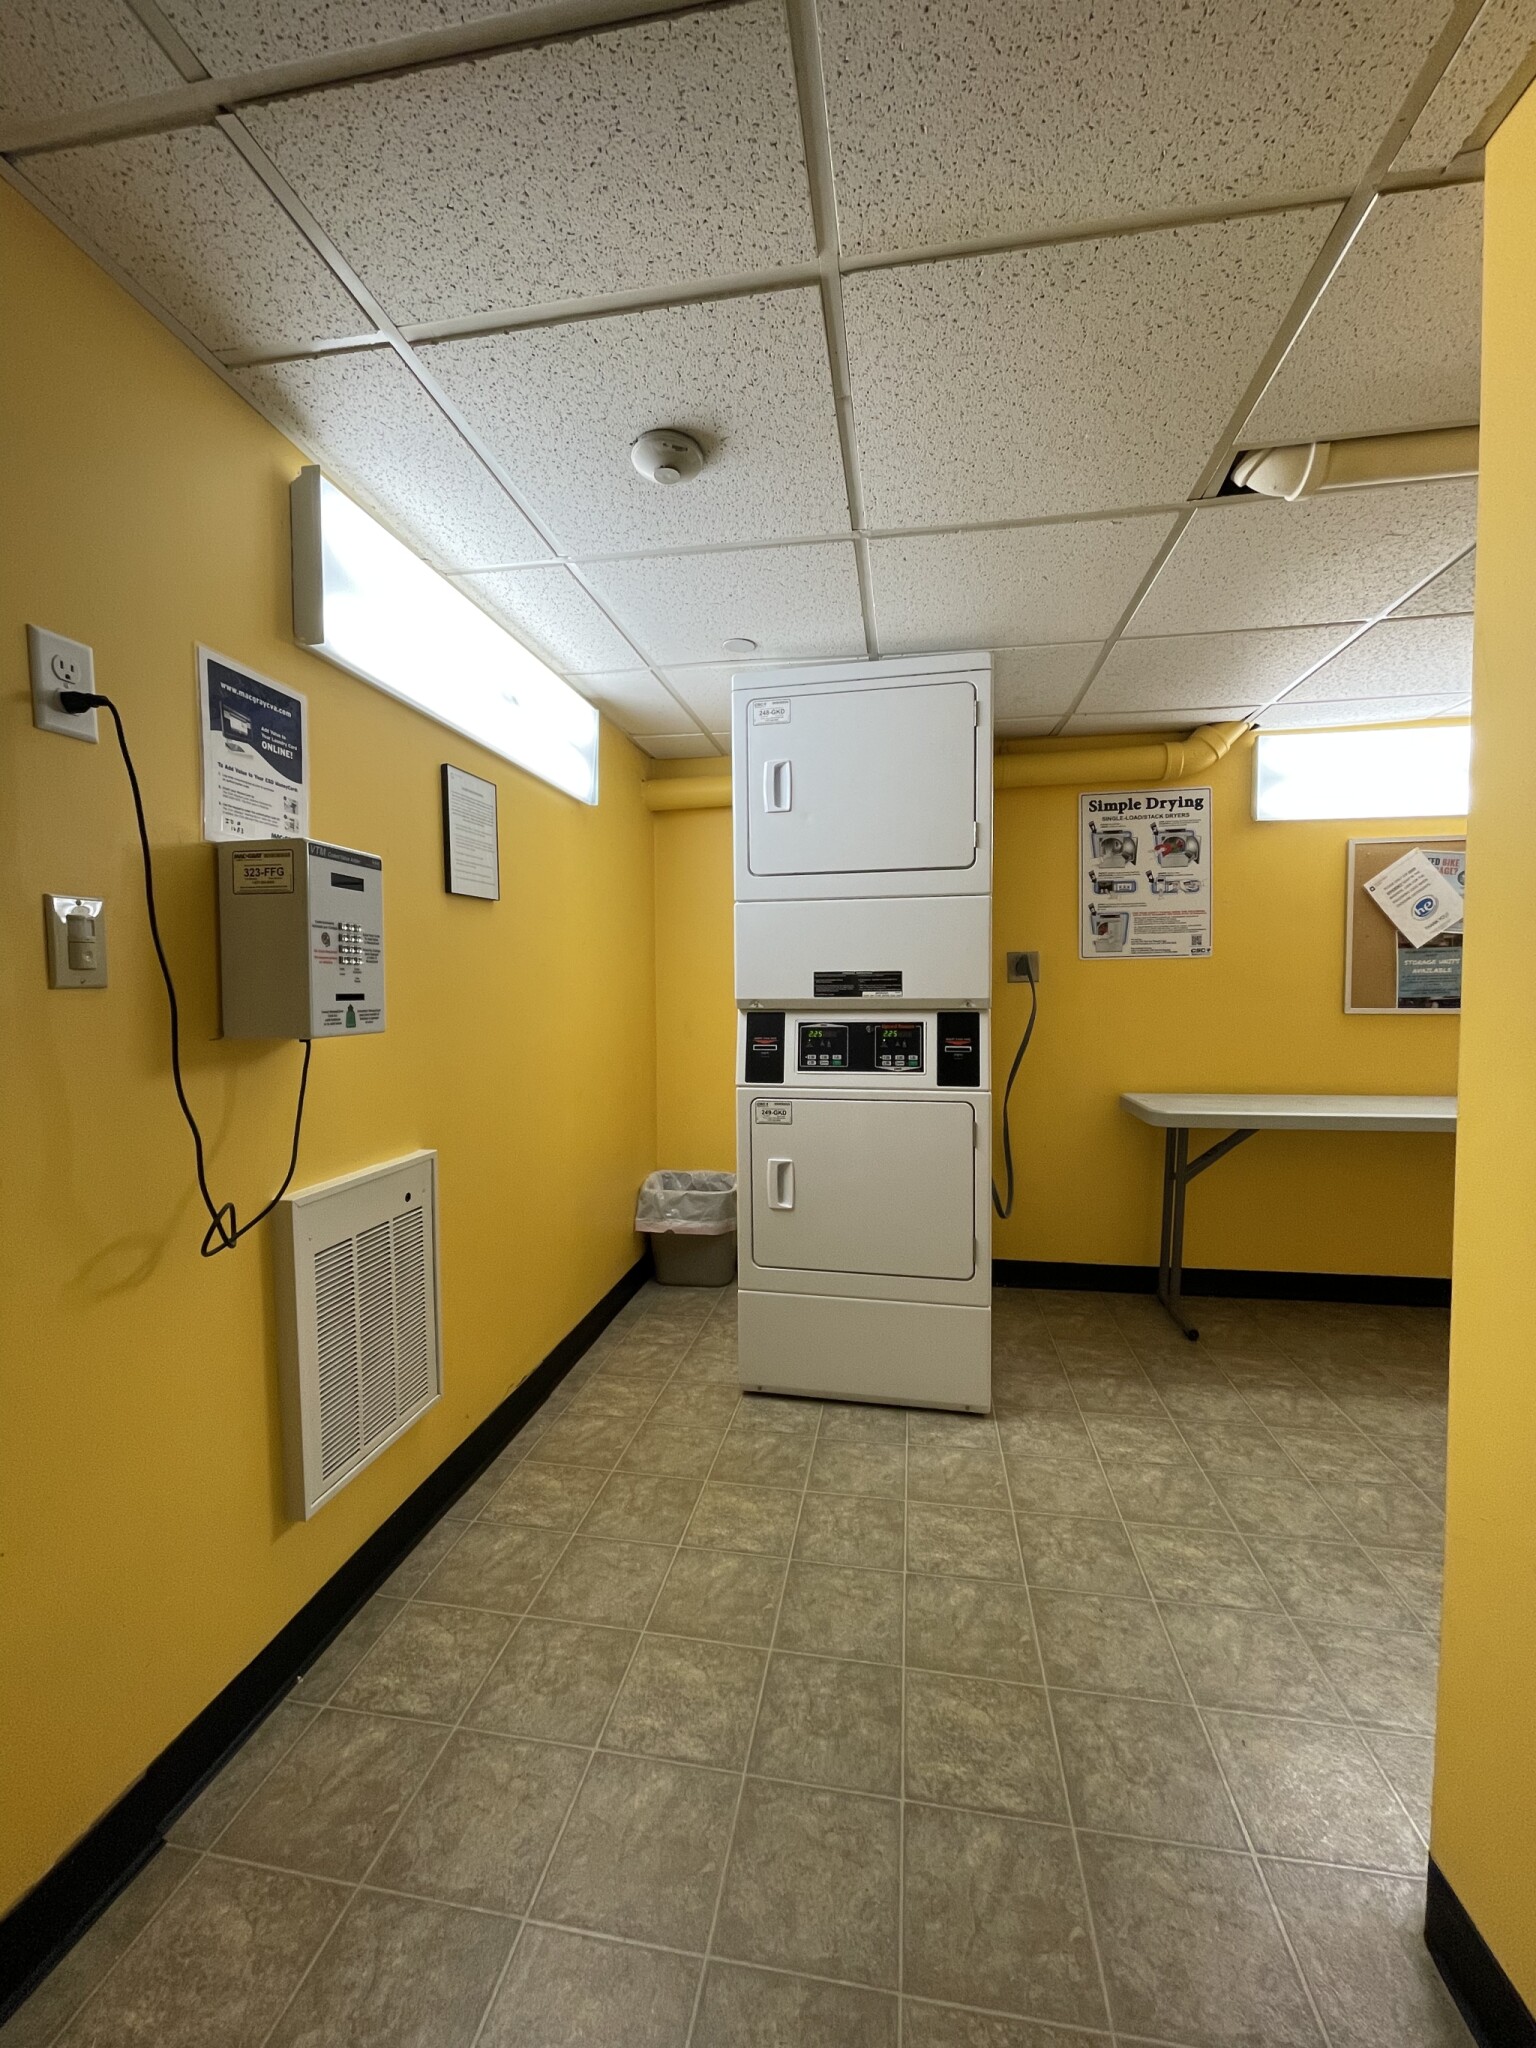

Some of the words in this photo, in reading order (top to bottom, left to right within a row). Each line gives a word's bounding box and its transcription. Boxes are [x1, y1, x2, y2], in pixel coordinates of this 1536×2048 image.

[261, 740, 294, 760] ONLINE!
[1088, 797, 1142, 815] Simple
[1145, 795, 1204, 812] Drying
[1442, 858, 1460, 867] BIKE
[243, 866, 285, 878] 323-FFG
